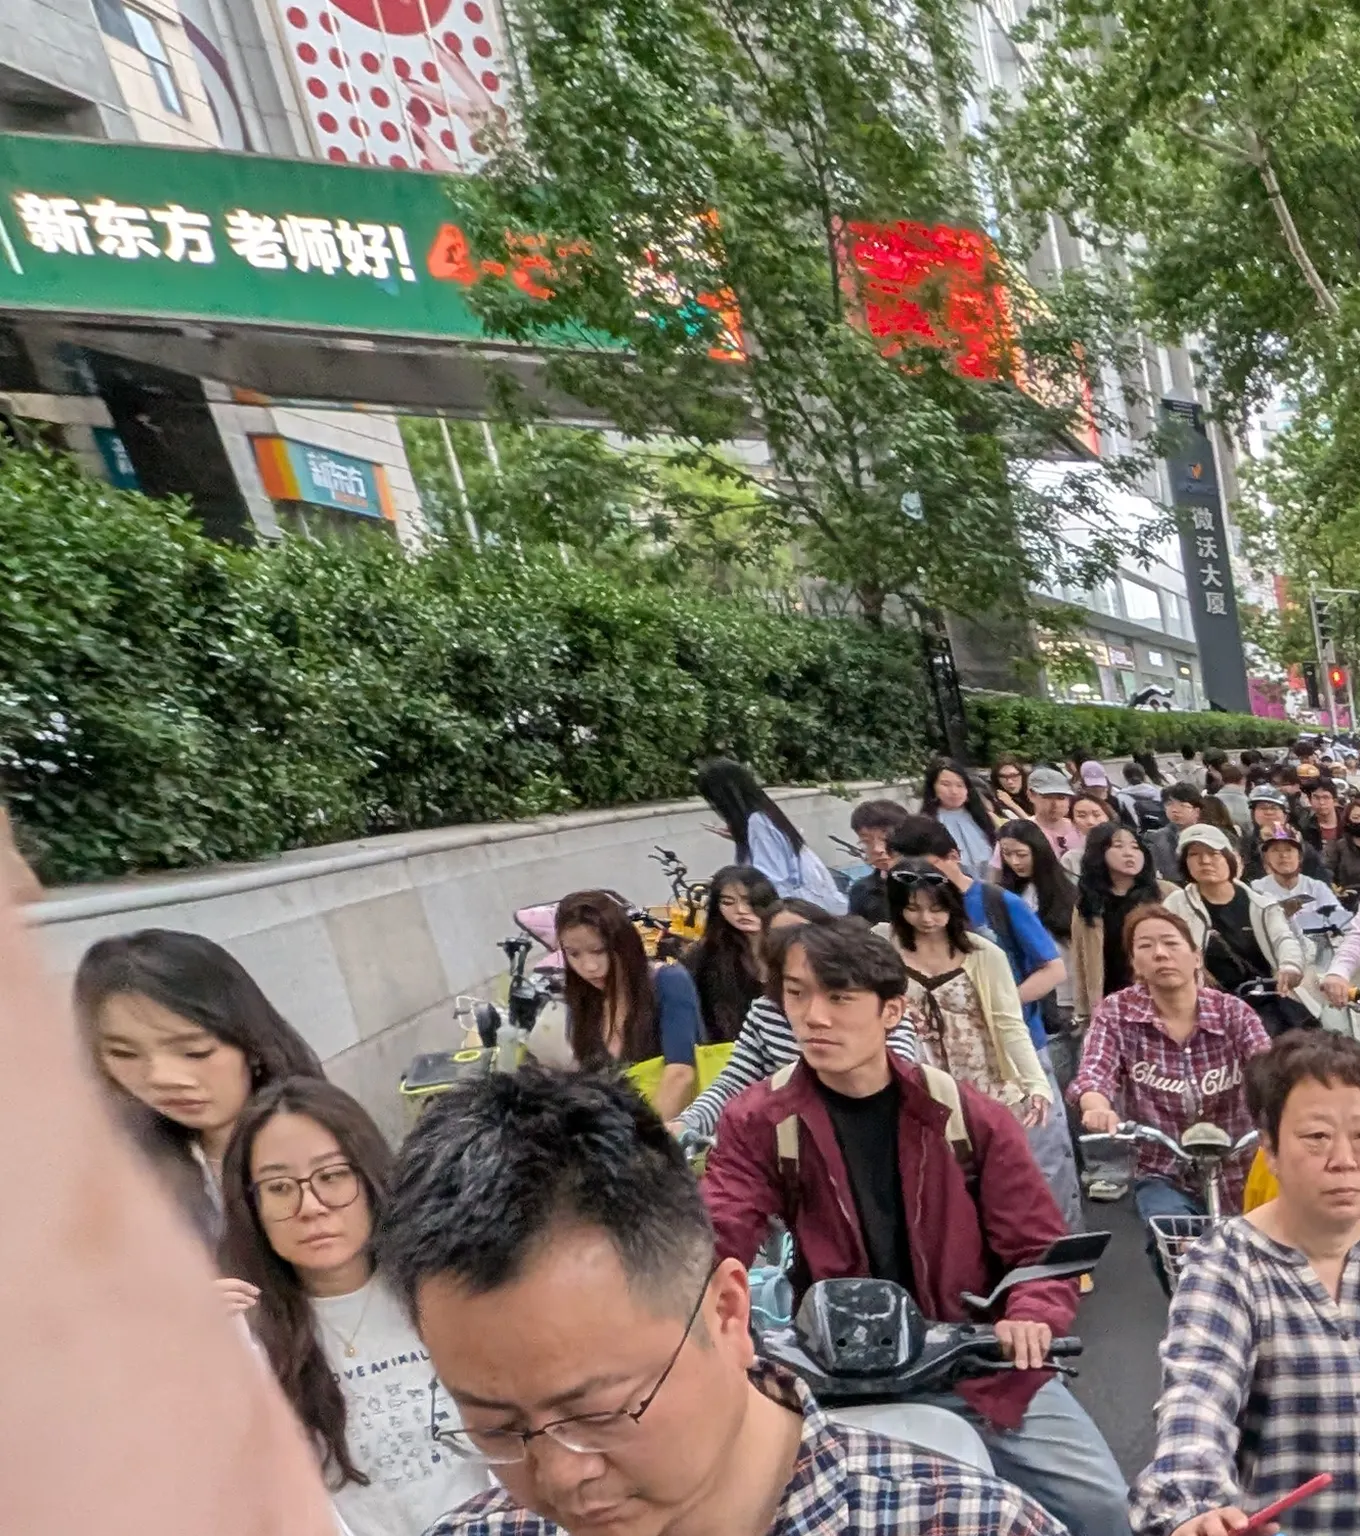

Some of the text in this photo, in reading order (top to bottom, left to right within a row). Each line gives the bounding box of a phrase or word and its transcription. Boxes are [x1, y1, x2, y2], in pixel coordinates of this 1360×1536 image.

[10, 192, 217, 265] 新东方
[223, 208, 417, 282] 老师好!
